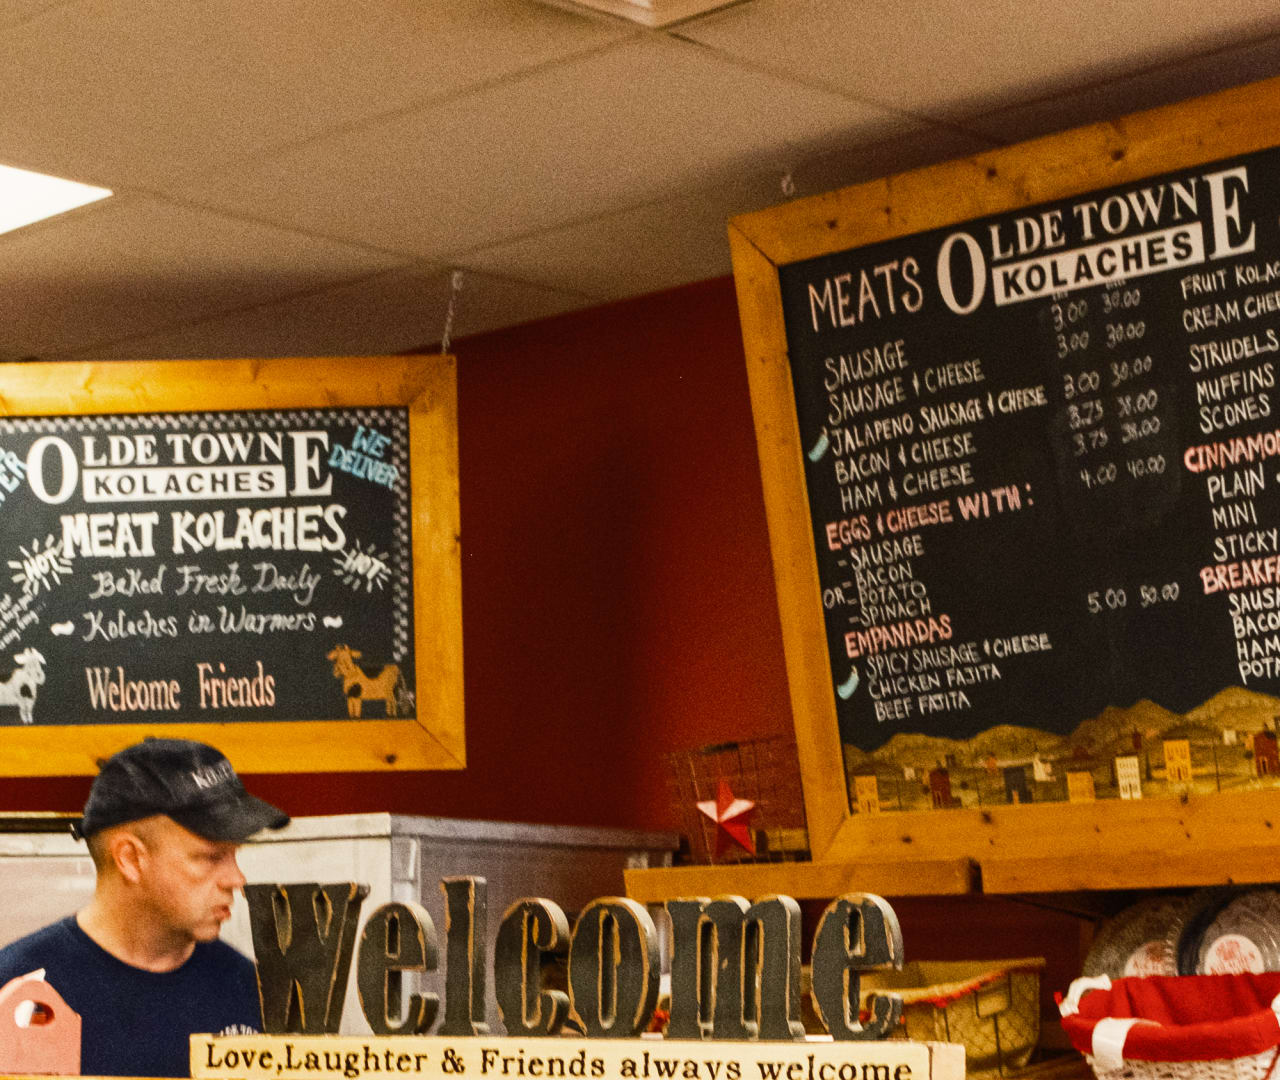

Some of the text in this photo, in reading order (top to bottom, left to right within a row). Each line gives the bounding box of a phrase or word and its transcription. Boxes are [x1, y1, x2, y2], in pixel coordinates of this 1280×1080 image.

[937, 165, 1256, 316] OLDE TOWNE
[1001, 231, 1194, 300] KOLACHES
[1180, 269, 1227, 300] FRUIT
[807, 256, 924, 333] MEATS
[1182, 298, 1241, 333] CREAM
[824, 339, 909, 392] SAUSAGE
[1188, 328, 1280, 373] STRUDELS
[828, 376, 907, 426] SAUSAGE
[924, 358, 986, 393] CHEESE
[1195, 362, 1275, 405] MUFFINS
[831, 413, 914, 457] JALAPENO
[920, 398, 985, 434] SAUSAGE
[997, 384, 1048, 413] CHEESE
[1199, 393, 1271, 434] SCONES
[351, 424, 392, 458] WE
[834, 447, 891, 485] BACON
[911, 432, 977, 464] CHEESE
[26, 430, 333, 505] OLDE TOWNE
[94, 470, 277, 496] KOLACHES
[328, 443, 400, 491] DELIVER
[840, 480, 883, 513] HAM
[902, 462, 975, 496] CHEESE
[1207, 461, 1266, 503] PLAIN
[59, 503, 348, 558] MEAT KOLACHES
[825, 514, 871, 551] EGGS
[886, 499, 954, 533] CHEESE
[1211, 500, 1258, 530] MINI
[342, 551, 392, 580] HOT
[850, 534, 925, 572] SAUSAGE
[1213, 528, 1278, 563] STICKY
[251, 561, 322, 606] Daily
[854, 562, 913, 590] BACON
[823, 588, 846, 609] OR
[860, 597, 931, 628] SPINACH
[82, 604, 317, 642] Kolaches in Warmers
[844, 613, 953, 659] EMPANADAS
[866, 632, 1052, 679] SPICY SAUSAGE CHEESE
[84, 659, 277, 711] Welcome Friends
[867, 663, 1002, 701] CHICKEN FAJITA
[874, 690, 972, 723] BEEF FAJITA
[243, 874, 904, 1040] Welcome
[441, 1048, 466, 1075] &
[480, 1048, 606, 1079] Friends
